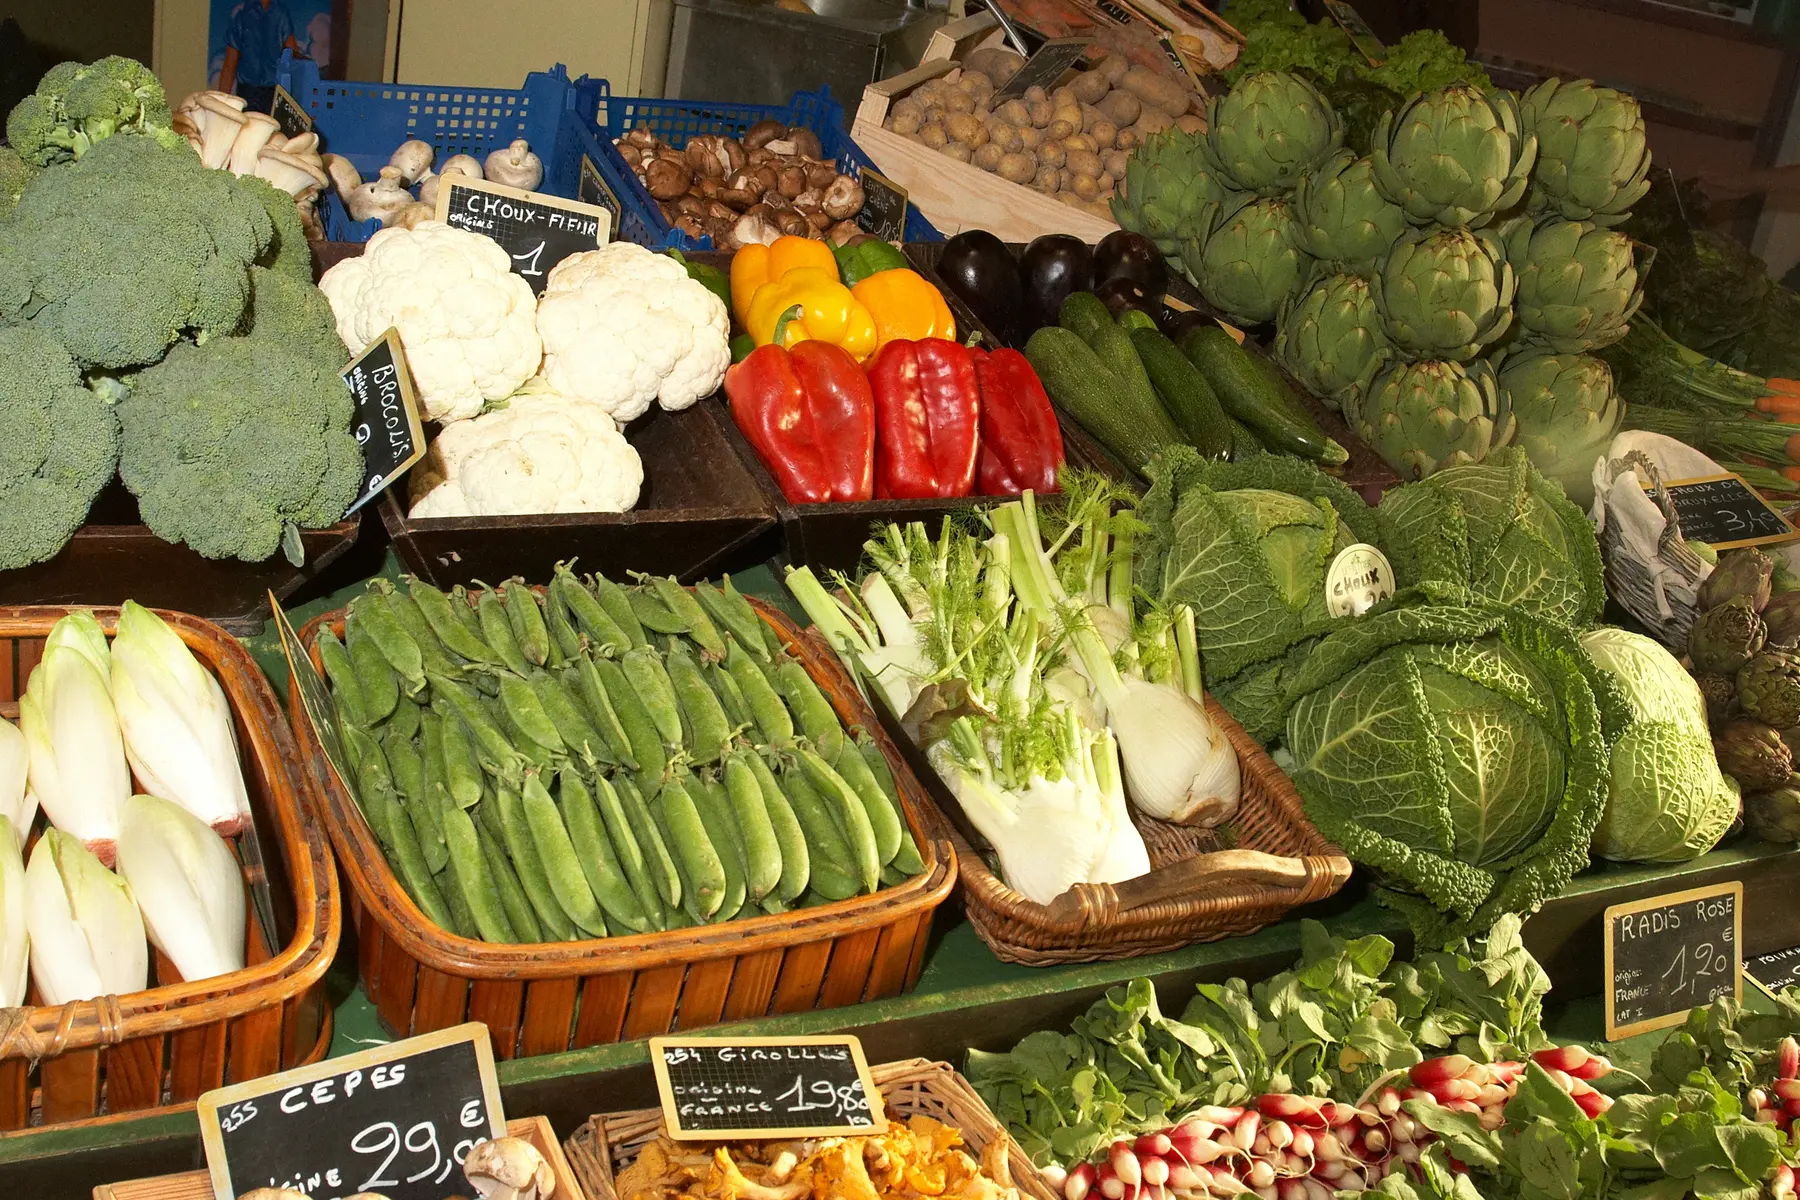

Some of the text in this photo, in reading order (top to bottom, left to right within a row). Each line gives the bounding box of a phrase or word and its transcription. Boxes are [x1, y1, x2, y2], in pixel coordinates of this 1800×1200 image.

[512, 240, 546, 276] 1
[1696, 896, 1734, 923] ROSE
[279, 1063, 406, 1115] CEPES
